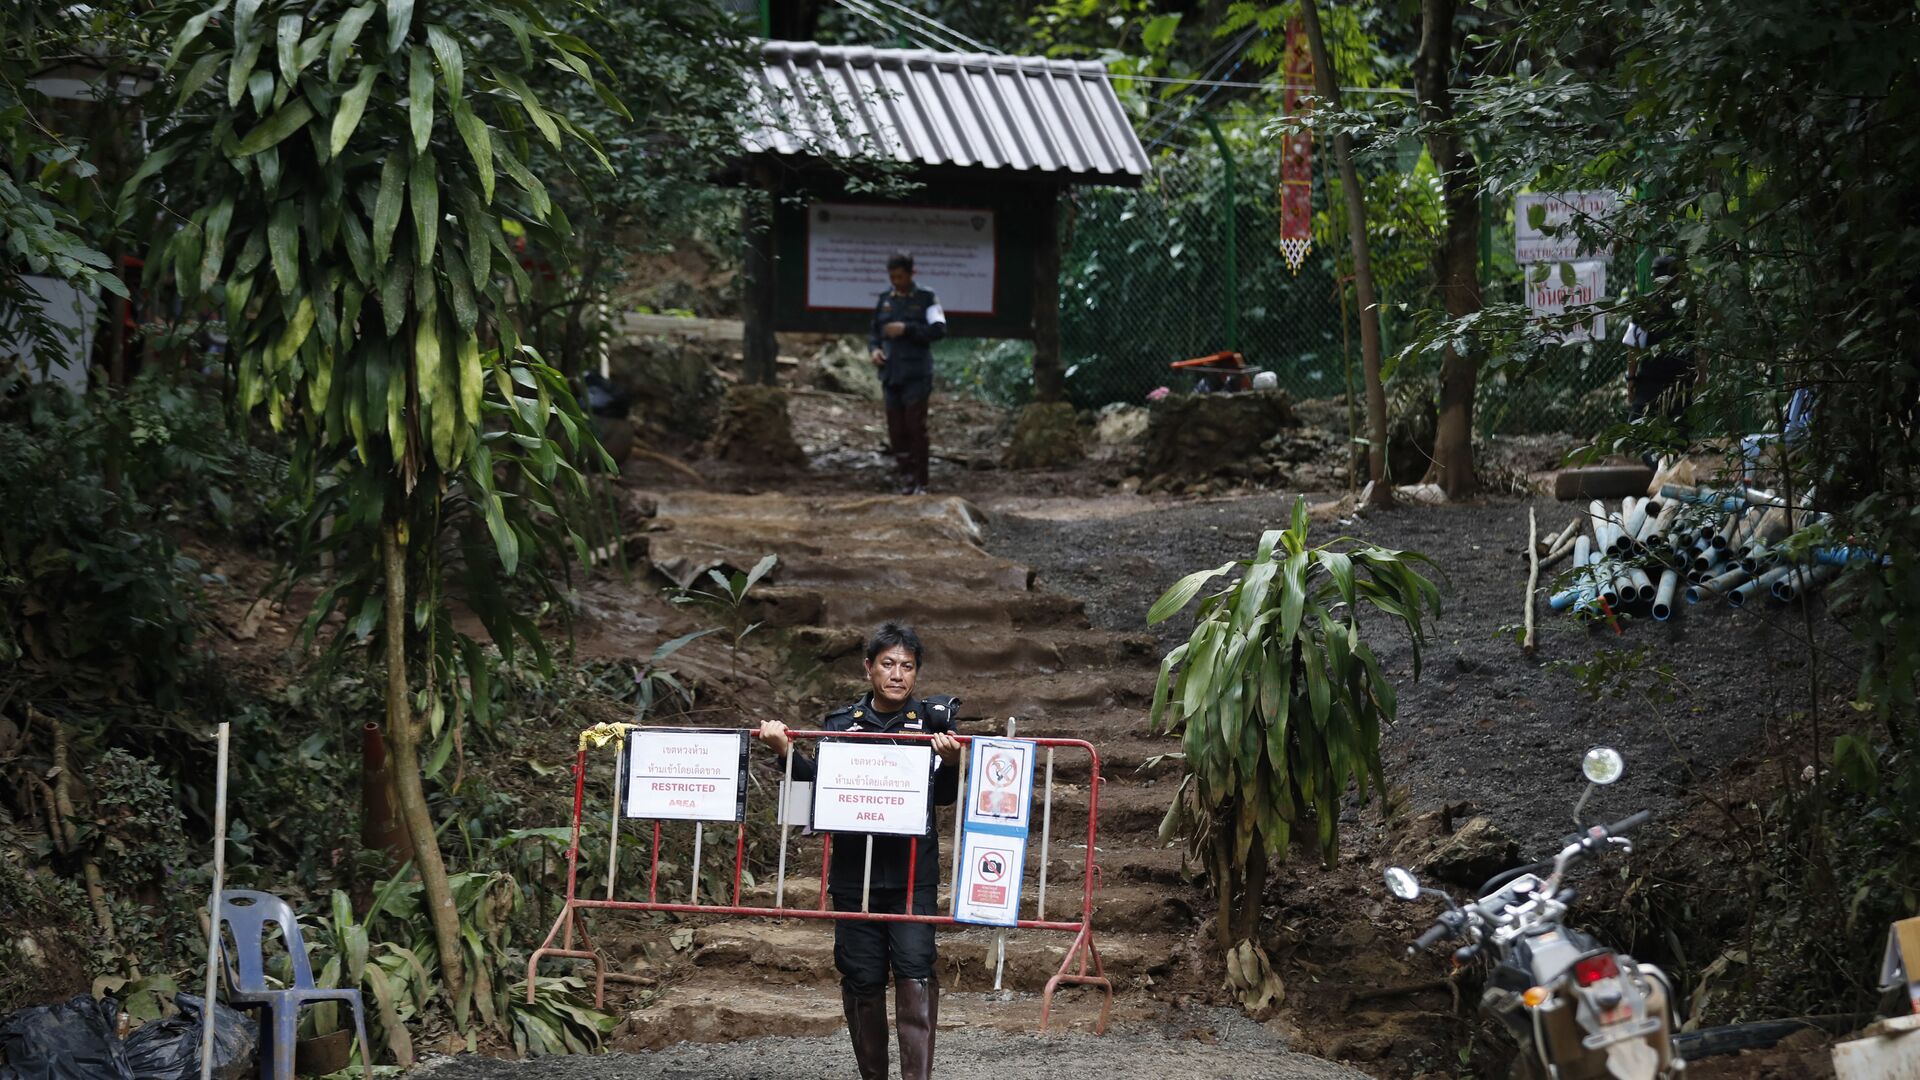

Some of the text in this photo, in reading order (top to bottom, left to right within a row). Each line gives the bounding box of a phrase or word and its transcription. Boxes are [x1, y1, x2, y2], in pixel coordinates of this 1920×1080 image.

[662, 744, 709, 756] เขตหวงห้าม
[647, 763, 721, 776] ห้ามเข้าโดยเด็ดขาด
[651, 782, 716, 793] RESTRICTED
[668, 799, 696, 808] AREA
[838, 794, 905, 806] RESTRICTED
[856, 811, 885, 821] AREA
